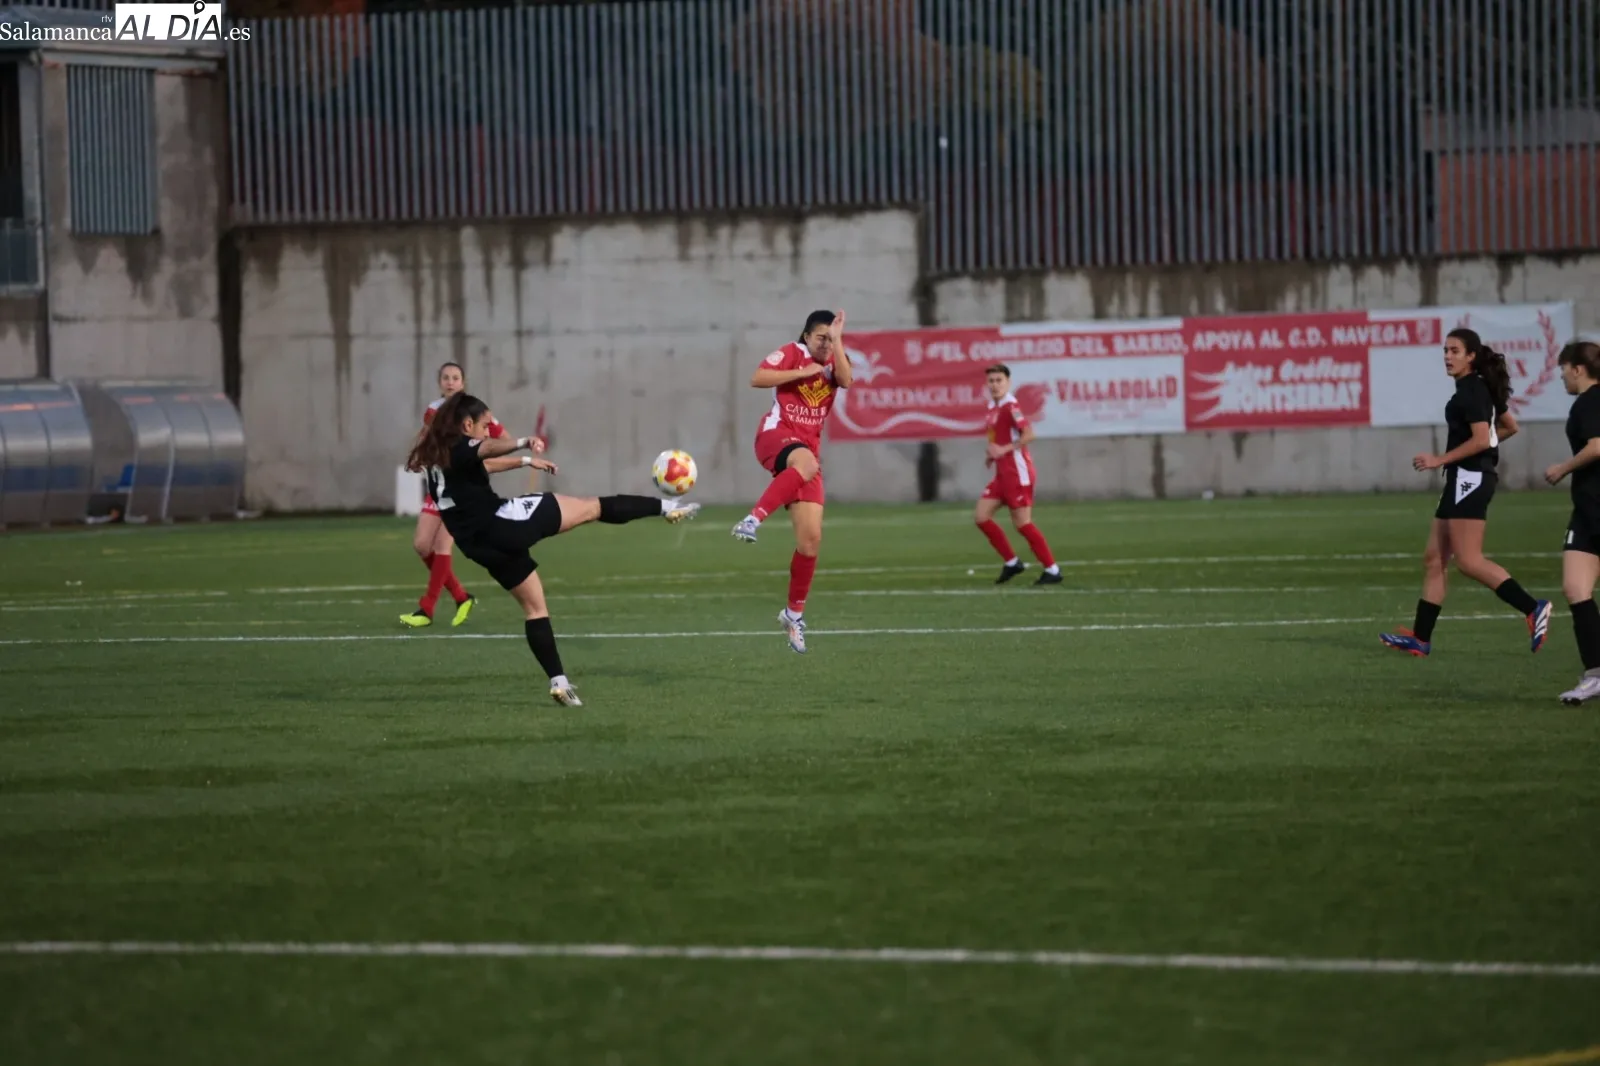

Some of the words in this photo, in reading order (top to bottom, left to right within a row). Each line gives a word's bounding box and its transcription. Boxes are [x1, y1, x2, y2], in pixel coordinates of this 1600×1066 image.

[1070, 335, 1108, 356] DEL
[1193, 329, 1255, 351] APOYA
[1259, 328, 1285, 349] AL
[1288, 326, 1327, 348] C.D.
[1332, 322, 1410, 346] NAVEGA
[1056, 376, 1178, 403] VALLADOLID
[785, 403, 809, 416] CAJA
